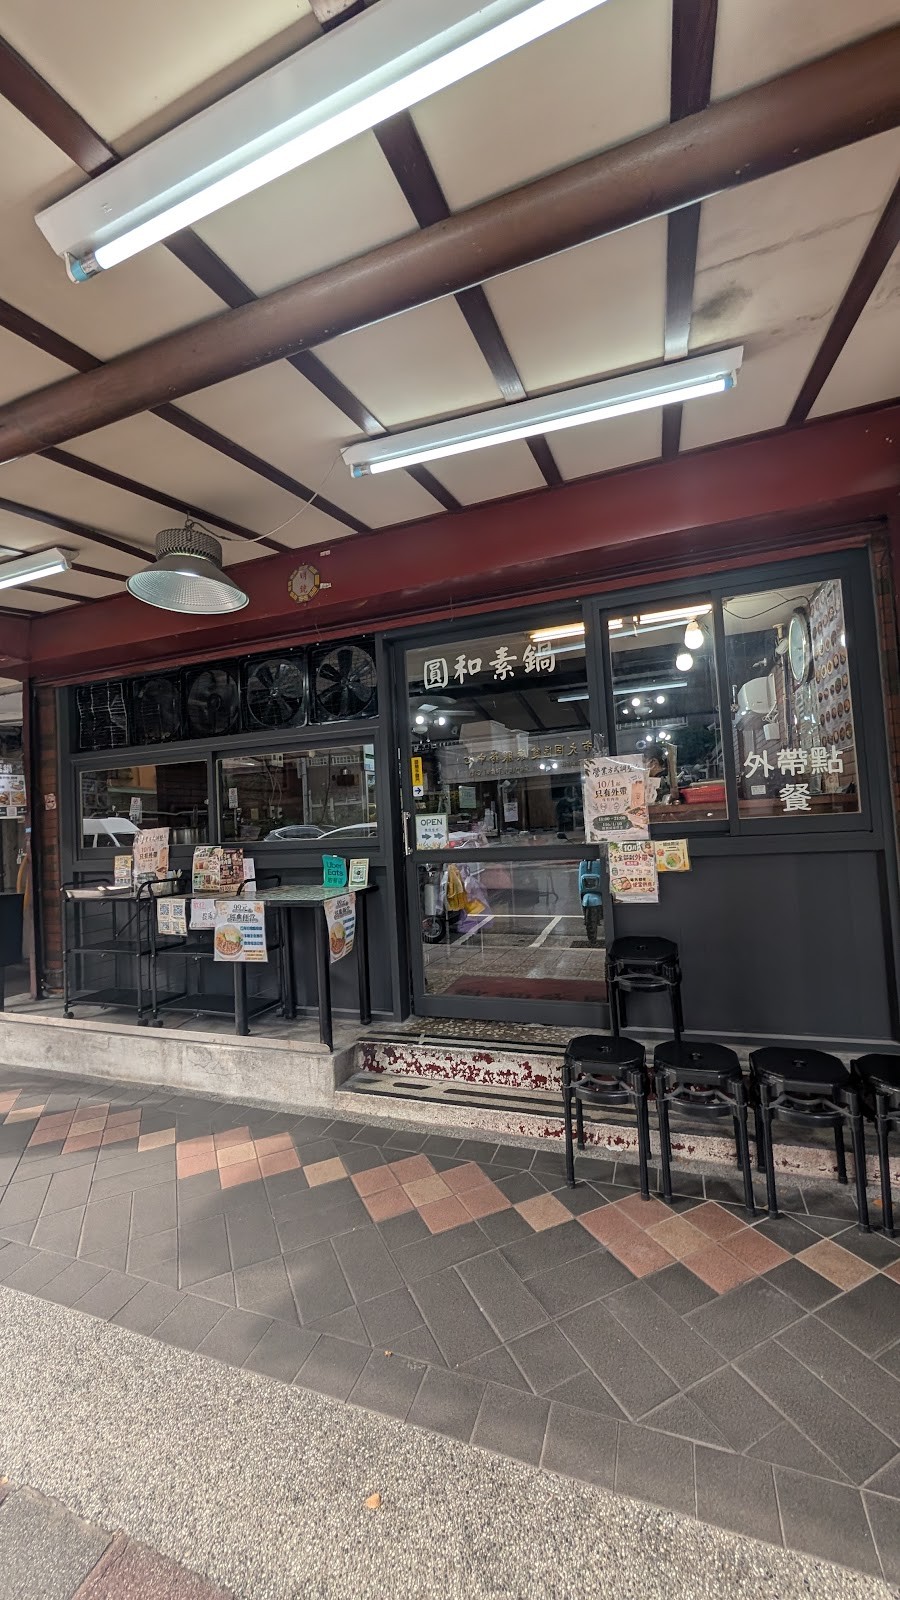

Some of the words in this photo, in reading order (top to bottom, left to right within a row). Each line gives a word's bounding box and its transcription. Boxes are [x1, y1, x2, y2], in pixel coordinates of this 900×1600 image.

[423, 641, 556, 690] 圓和素鍋
[743, 745, 844, 779] 外帶點
[595, 786, 628, 799] 只有外帶
[779, 783, 812, 812] 餐
[420, 818, 443, 827] OPEN
[326, 861, 342, 869] Uber
[327, 869, 344, 877] Eats
